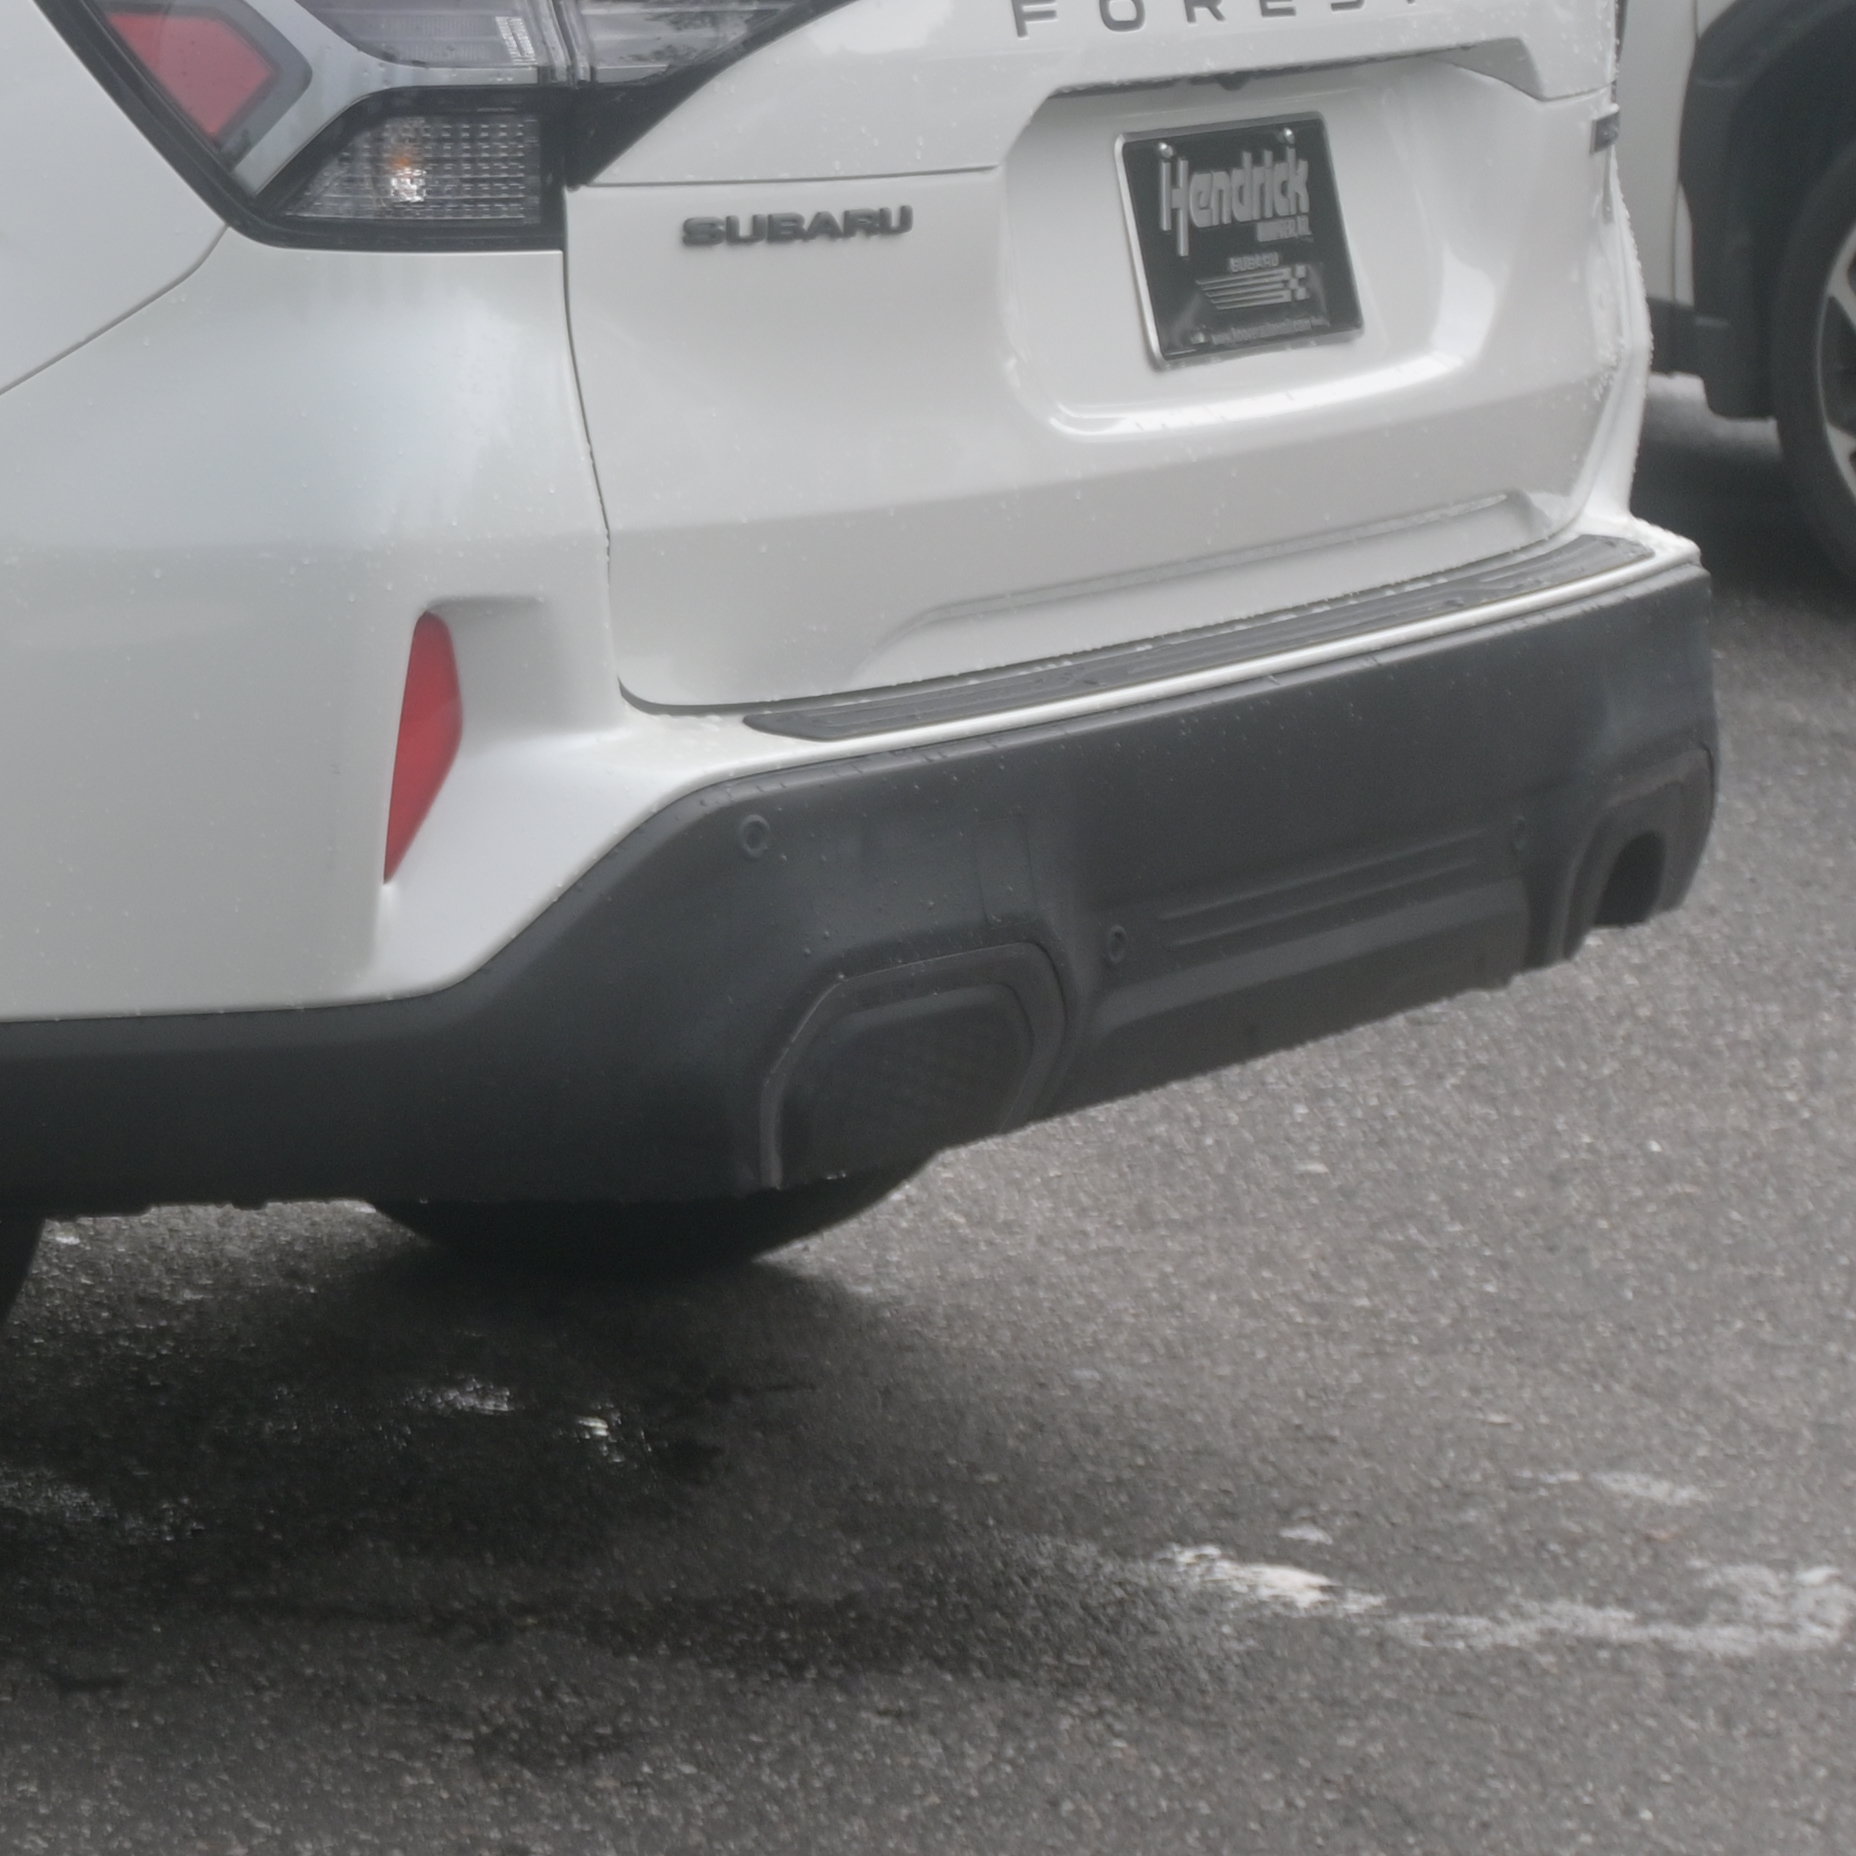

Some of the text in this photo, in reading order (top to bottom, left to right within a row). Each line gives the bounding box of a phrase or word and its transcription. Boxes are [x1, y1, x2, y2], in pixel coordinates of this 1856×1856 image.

[1159, 146, 1310, 256] Hendrick
[682, 204, 913, 247] SUBARU
[1229, 251, 1280, 273] SUBARU
